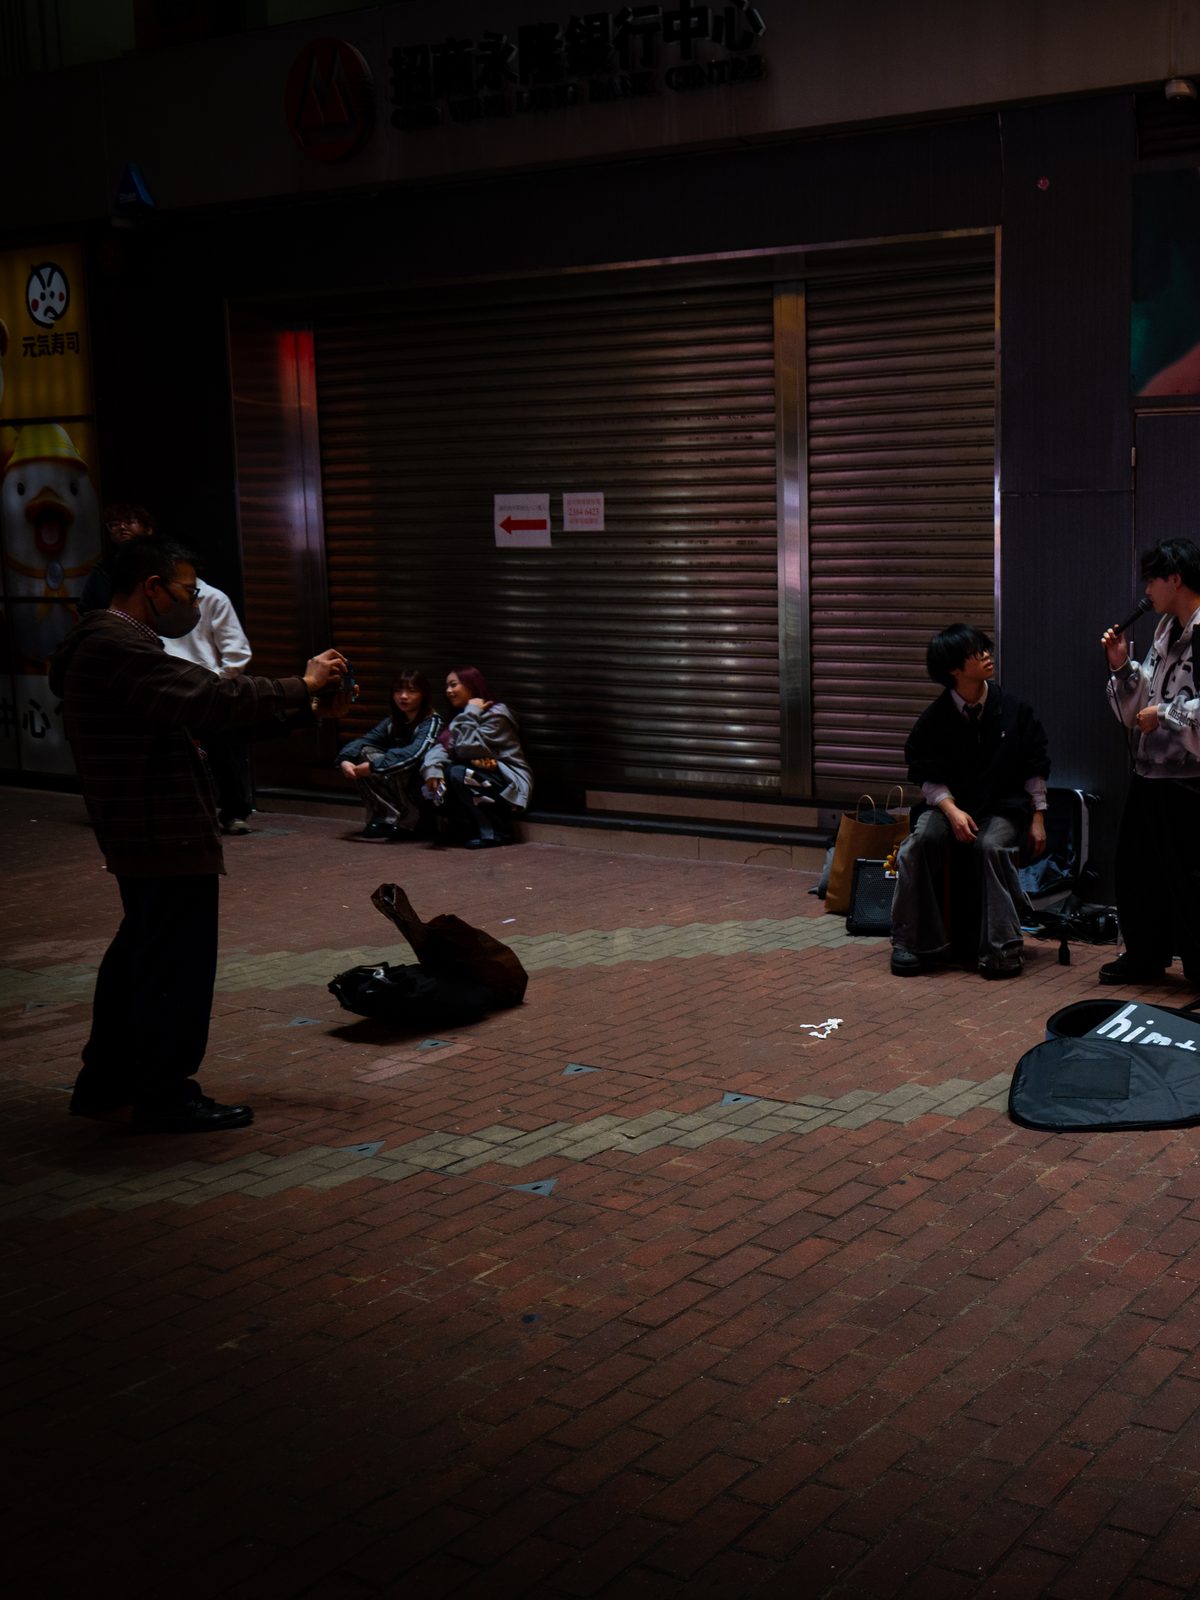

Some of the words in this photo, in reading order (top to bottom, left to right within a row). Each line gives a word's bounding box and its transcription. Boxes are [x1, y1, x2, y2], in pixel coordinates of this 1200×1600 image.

[665, 54, 765, 91] CENTRE
[22, 332, 80, 358] 元気寿司
